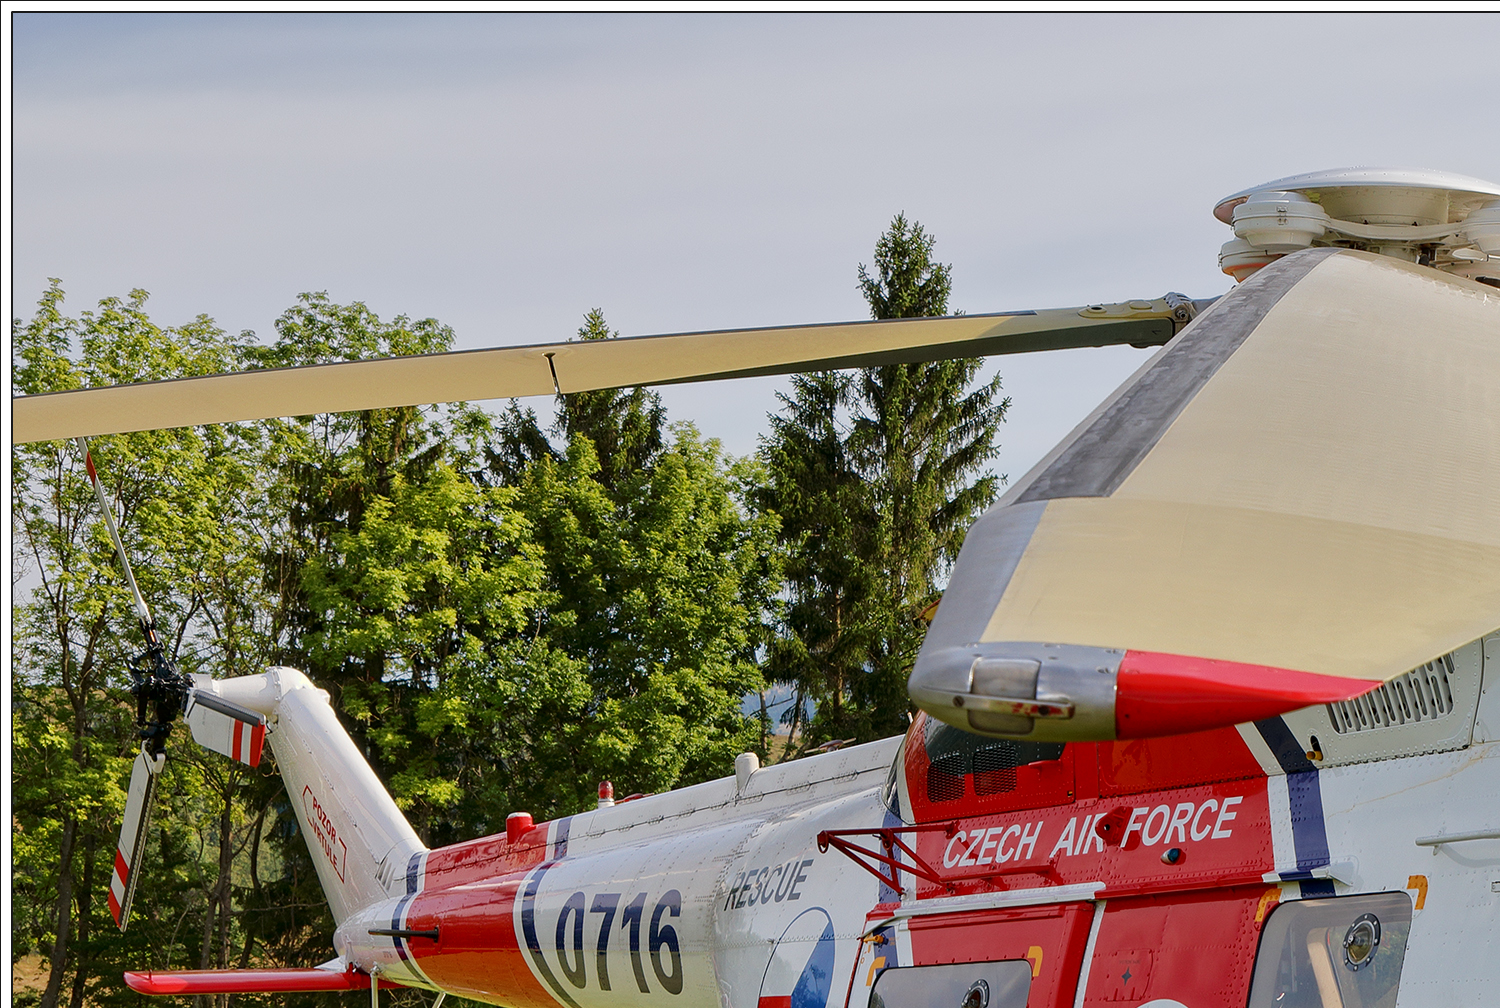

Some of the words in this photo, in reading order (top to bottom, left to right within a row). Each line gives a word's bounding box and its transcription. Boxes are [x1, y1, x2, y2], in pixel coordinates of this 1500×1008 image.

[312, 796, 337, 844] POZOR
[312, 817, 338, 866] VRTULE
[942, 820, 1044, 869] CZECH
[1049, 813, 1108, 858] AIR
[1120, 796, 1244, 848] FORCE
[724, 859, 815, 912] RESCUE
[555, 889, 684, 995] 0716
